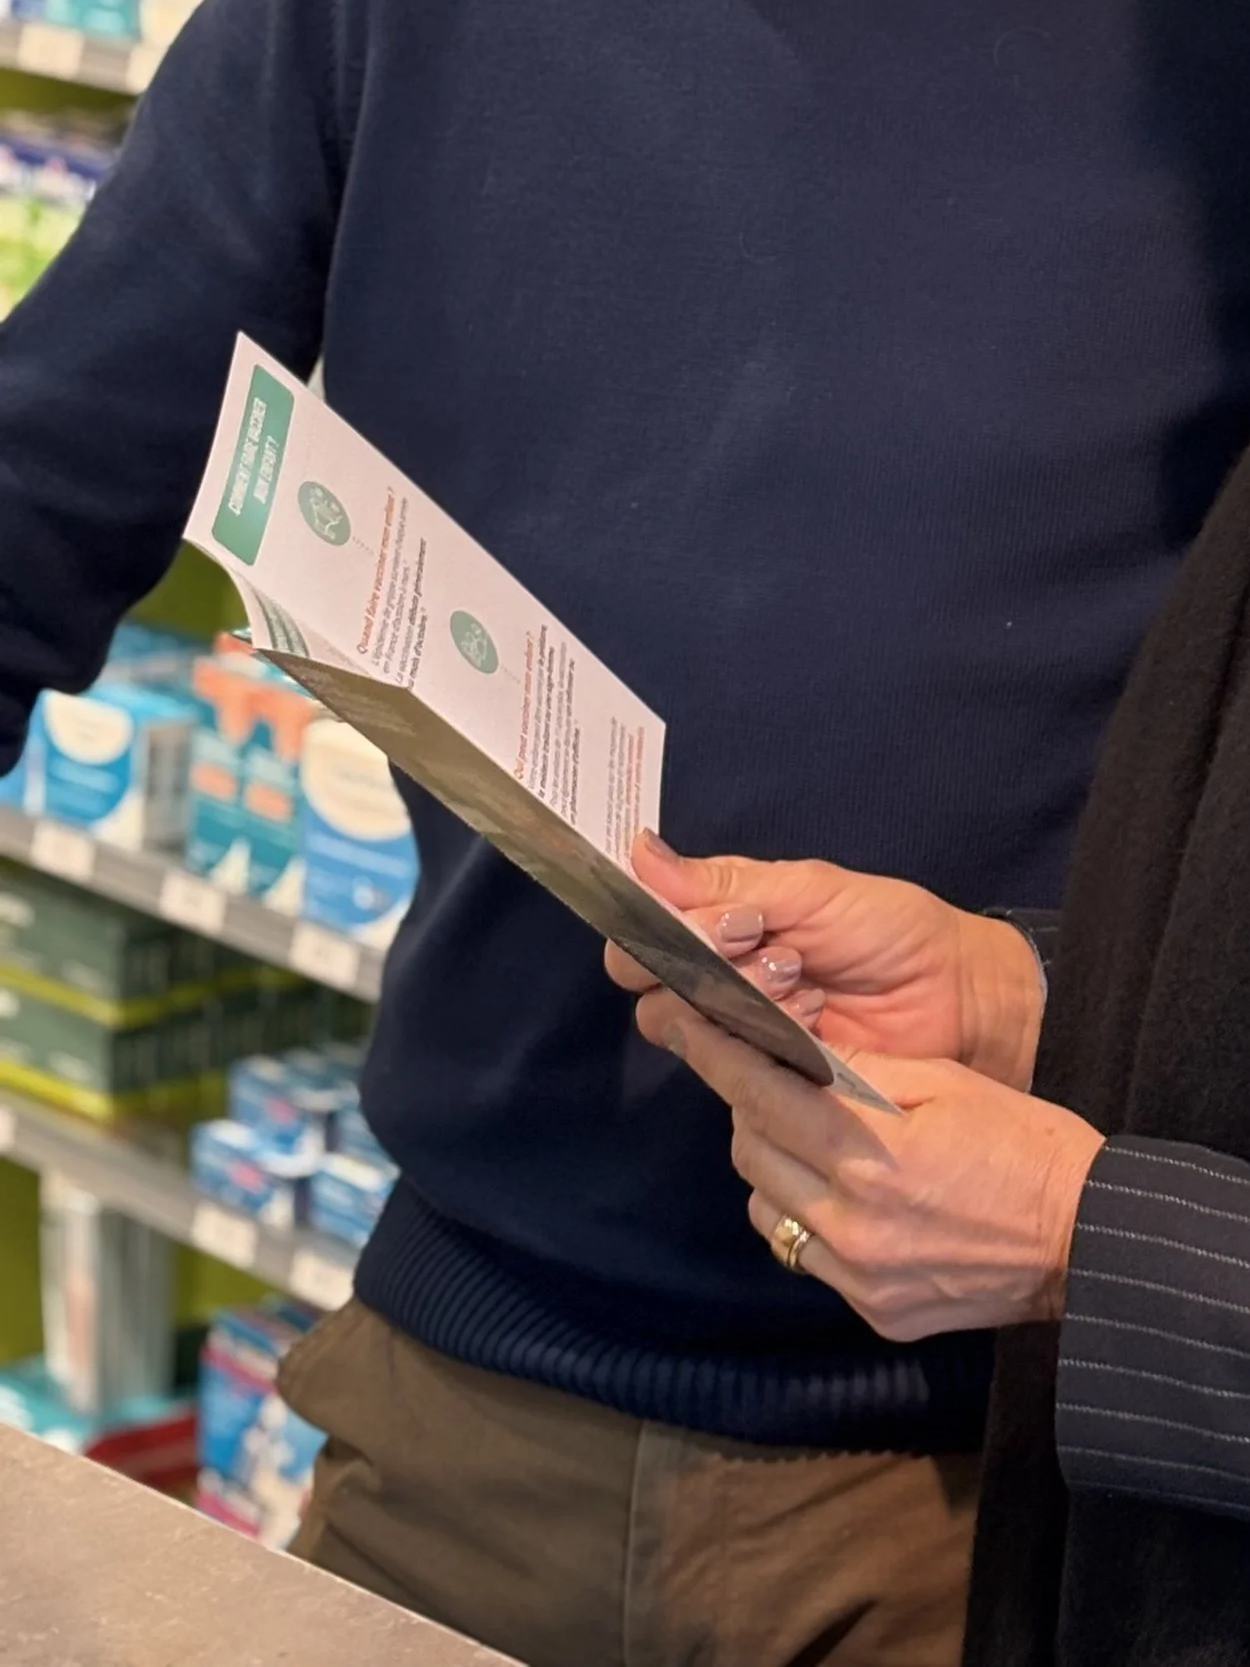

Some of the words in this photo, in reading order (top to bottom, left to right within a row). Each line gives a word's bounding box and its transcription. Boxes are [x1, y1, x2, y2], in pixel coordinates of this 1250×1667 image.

[246, 395, 267, 444] VACCINER
[240, 437, 257, 474] FAIRE
[259, 442, 277, 481] ENFANT
[228, 467, 249, 516] COMMENT
[382, 492, 395, 528] enfant
[381, 525, 390, 550] mon
[372, 546, 386, 593] vacciner
[365, 588, 378, 618] faire
[356, 613, 373, 657] Quand
[524, 638, 534, 672] enfant
[524, 670, 532, 695] mon
[520, 694, 530, 736] vacciner
[518, 734, 527, 762] peut
[514, 757, 524, 781] Qui
[539, 751, 548, 789] médecin
[568, 763, 579, 814] pharmacien
